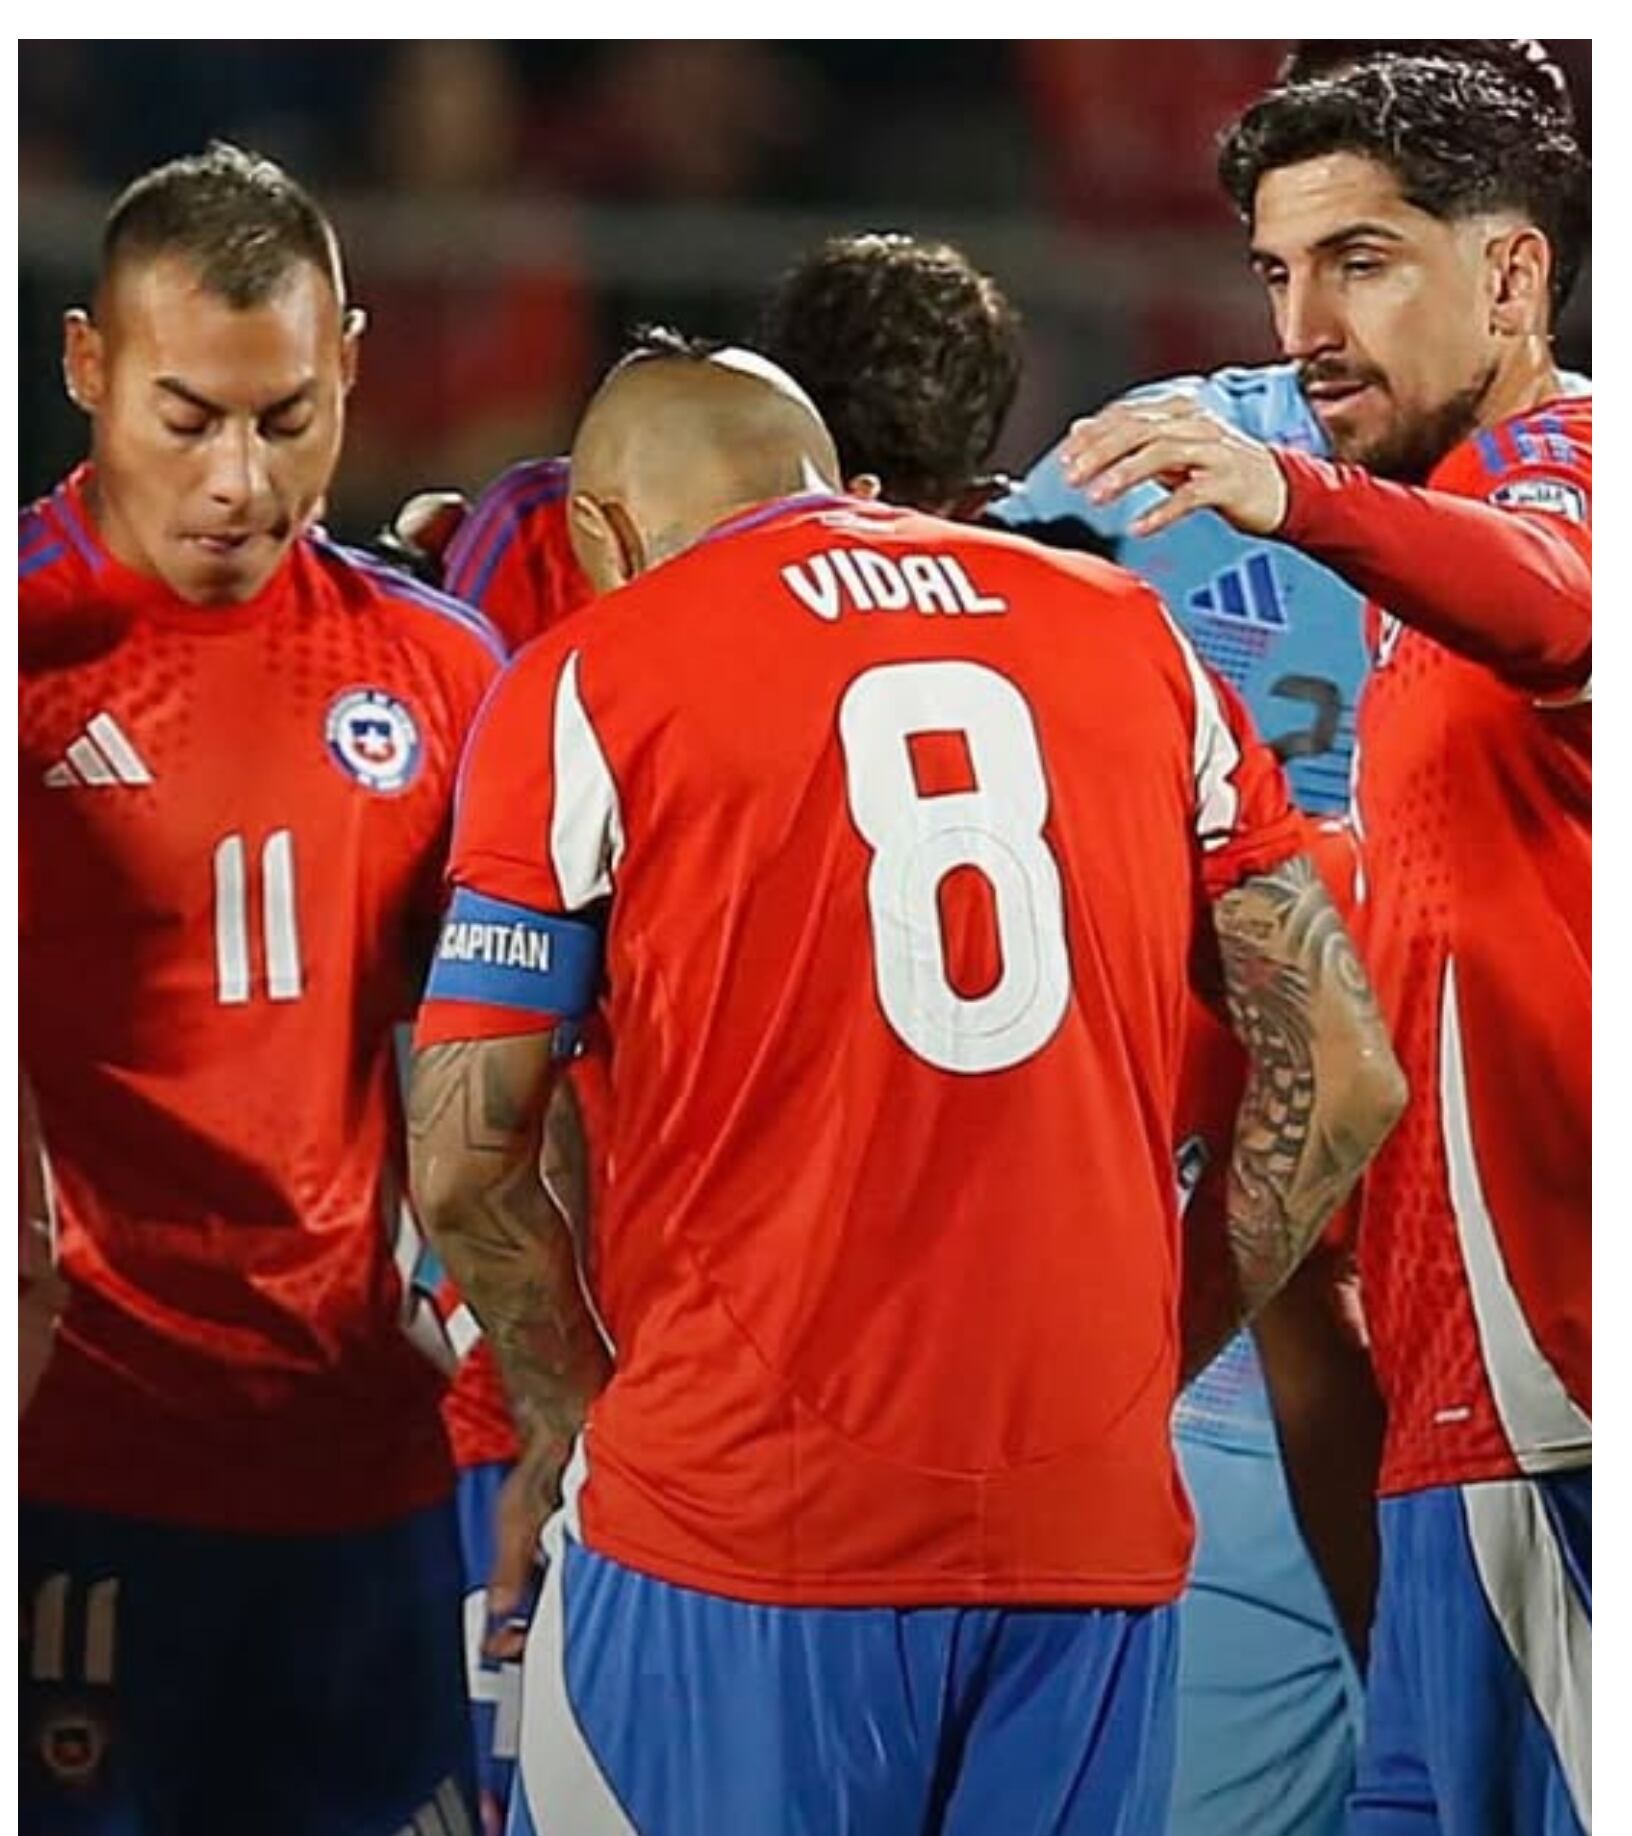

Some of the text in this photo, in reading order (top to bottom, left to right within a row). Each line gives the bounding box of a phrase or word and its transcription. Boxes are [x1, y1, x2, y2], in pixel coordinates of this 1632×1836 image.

[781, 548, 1008, 621] VIDAL
[214, 830, 302, 1003] 11
[838, 660, 1072, 1073] 8
[30, 1572, 120, 1683] 11
